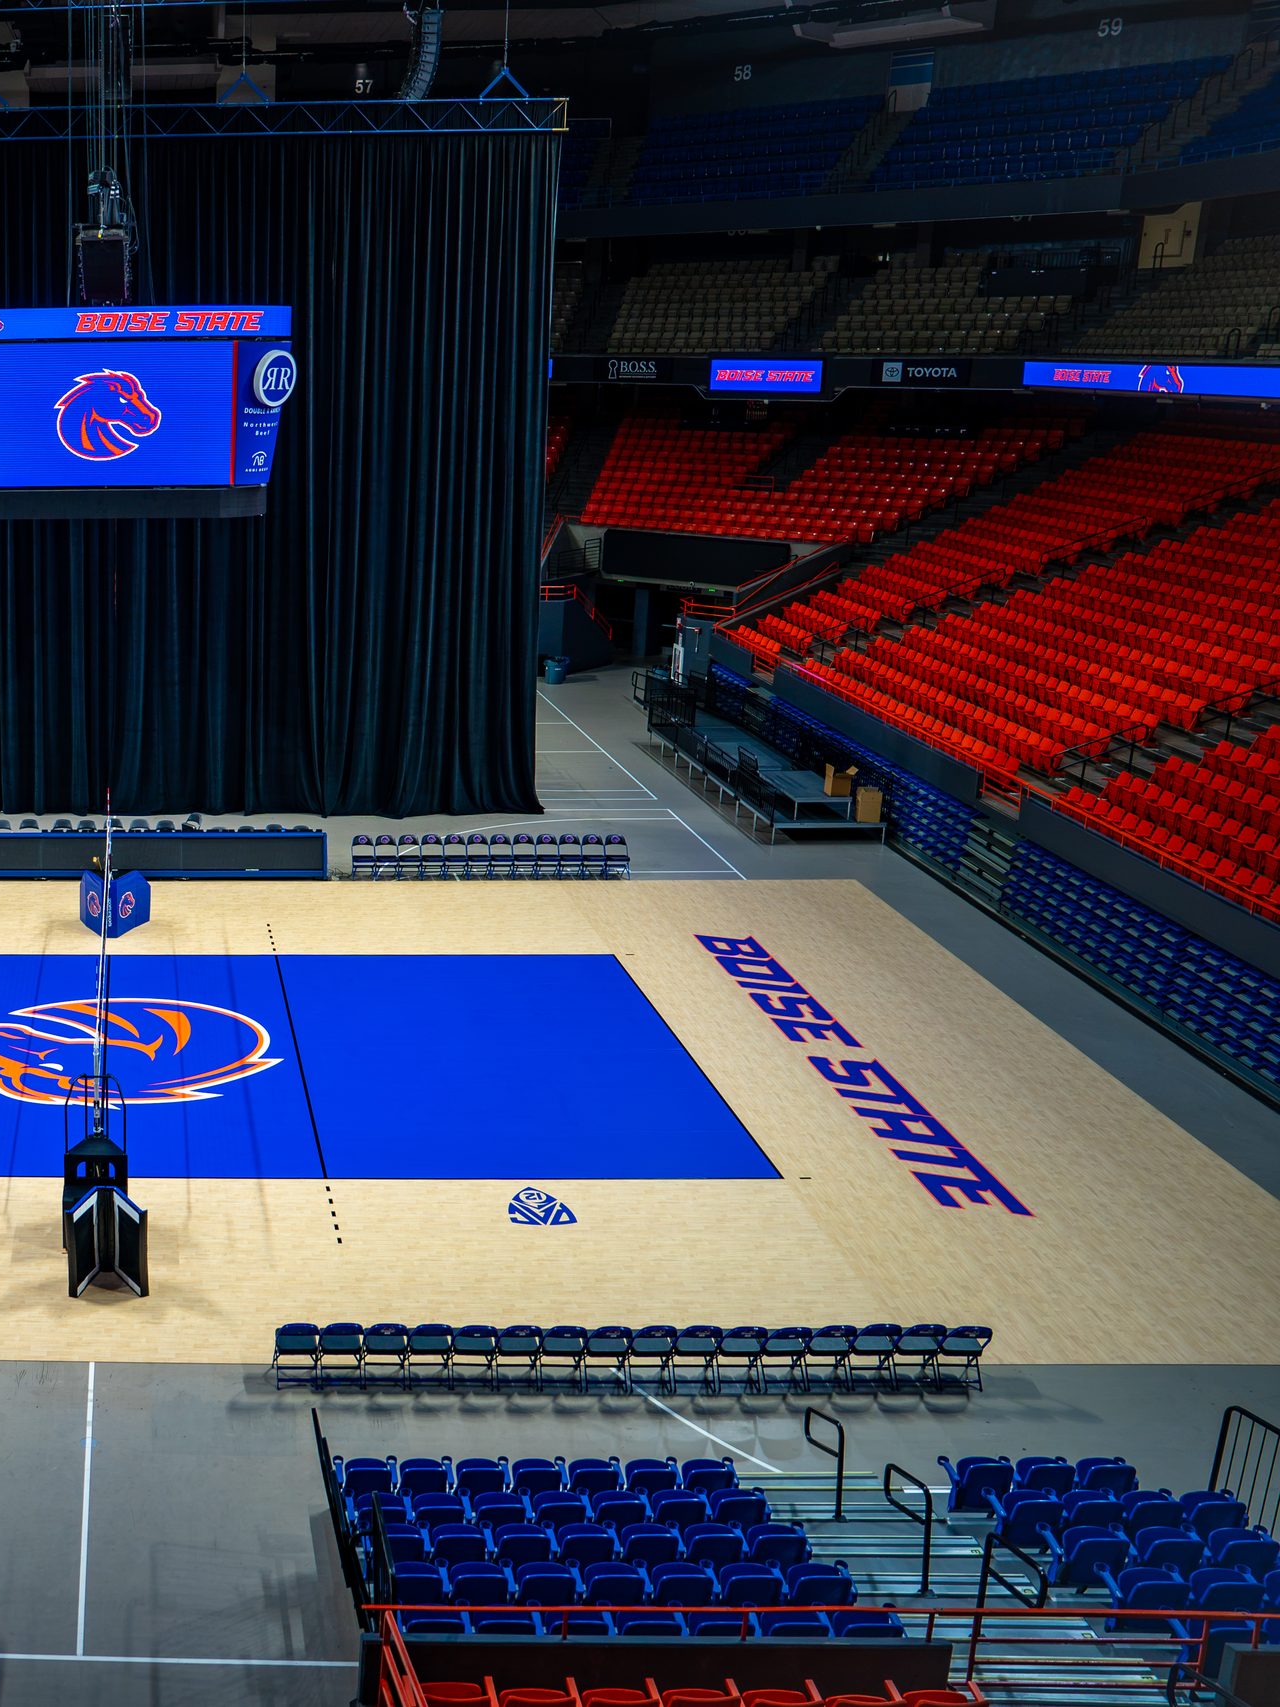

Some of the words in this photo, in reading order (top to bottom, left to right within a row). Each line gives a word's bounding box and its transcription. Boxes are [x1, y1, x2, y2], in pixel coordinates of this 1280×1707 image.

[1097, 17, 1123, 37] 59
[733, 64, 752, 81] 58
[354, 79, 374, 94] 57
[75, 311, 170, 332] BOISE
[174, 310, 264, 331] STATE
[620, 360, 657, 373] B.O.S.S.
[907, 367, 958, 378] TOYOTA
[715, 369, 766, 381] BOISE
[766, 370, 816, 382] STATE
[1053, 368, 1082, 382] BOISE
[1082, 369, 1112, 383] STATE
[693, 934, 864, 1049] BOISE
[806, 1057, 1036, 1218] STATE
